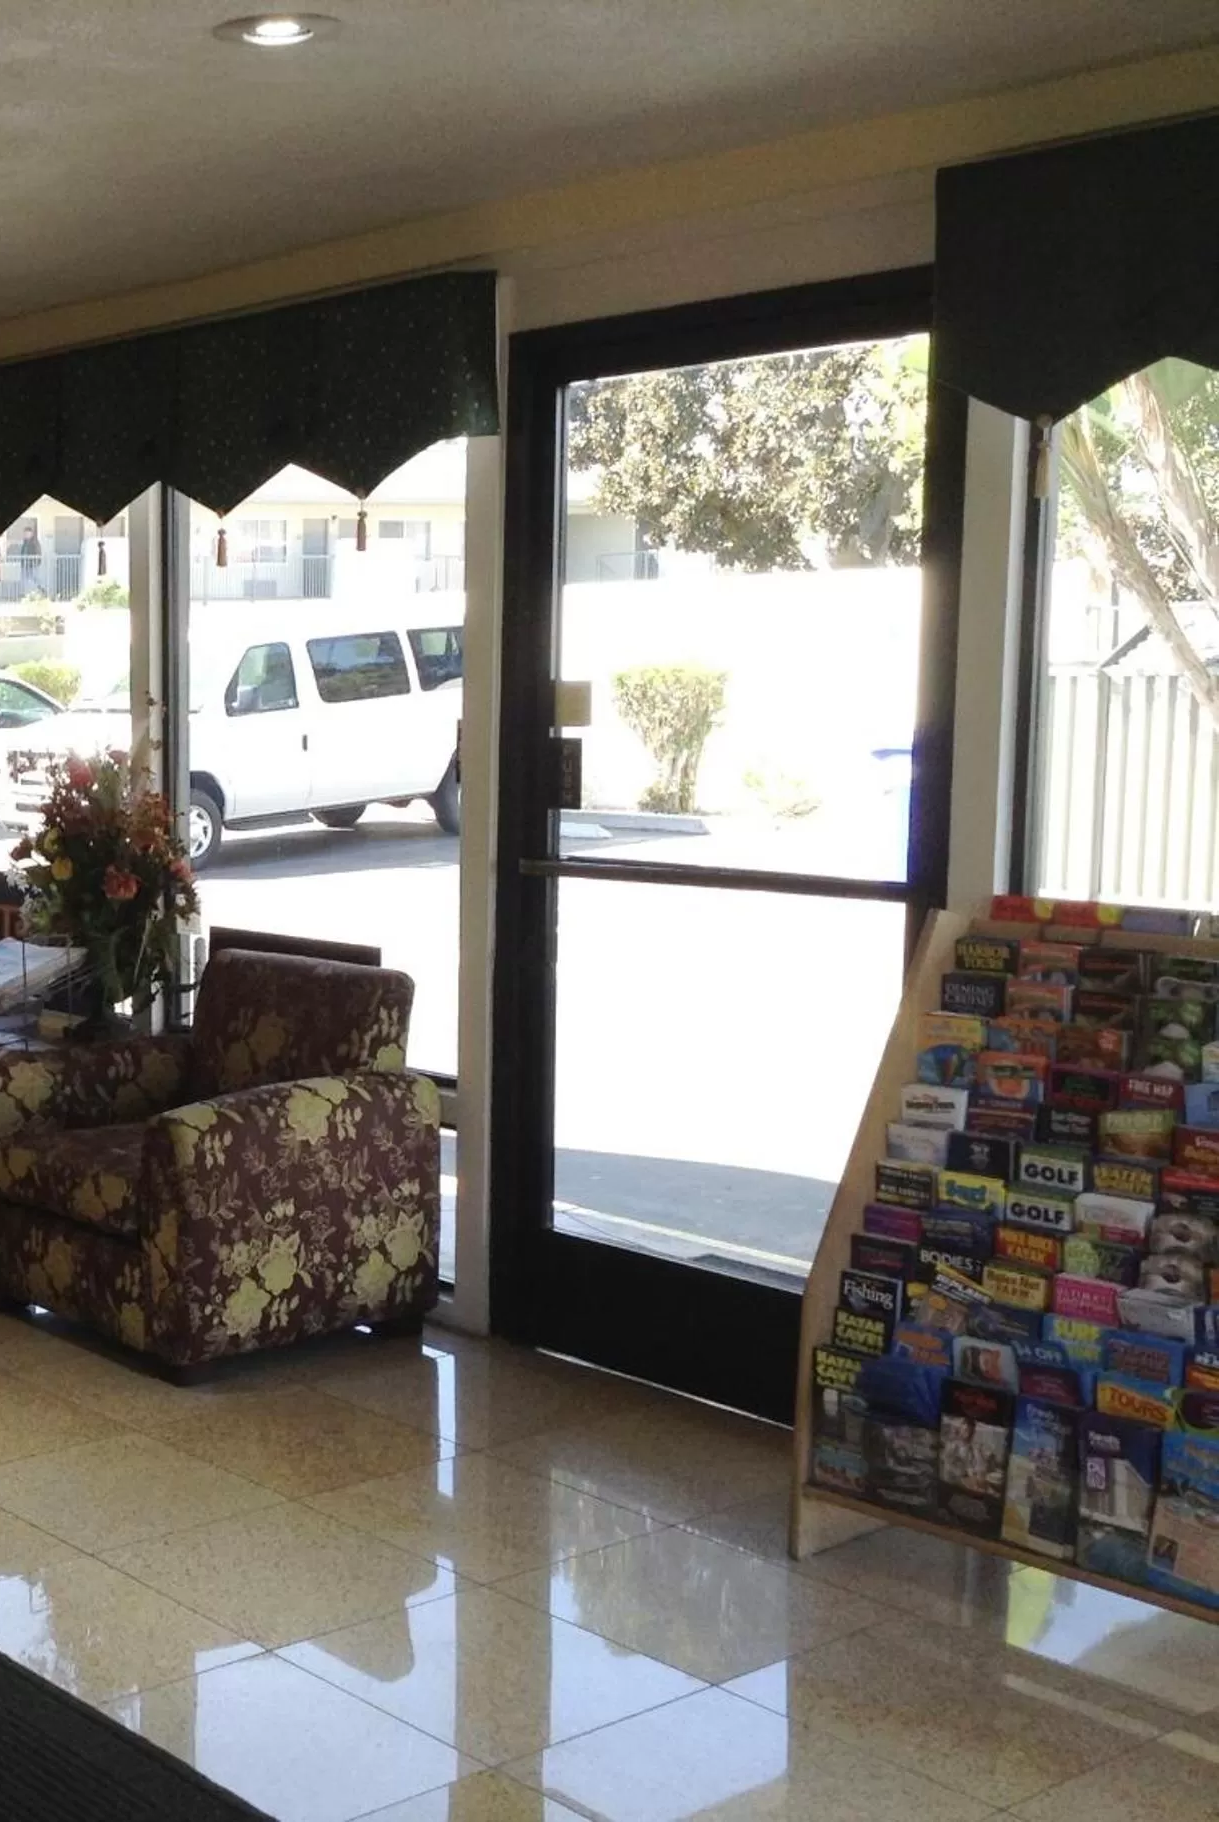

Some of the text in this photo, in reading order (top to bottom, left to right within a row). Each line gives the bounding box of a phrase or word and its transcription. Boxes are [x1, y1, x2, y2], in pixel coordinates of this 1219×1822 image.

[1024, 1163, 1079, 1186] GOLF
[1010, 1202, 1066, 1225] GOLF
[919, 1248, 974, 1271] BODIES
[844, 1278, 894, 1311] Fishing
[1108, 1386, 1168, 1422] TOURS
